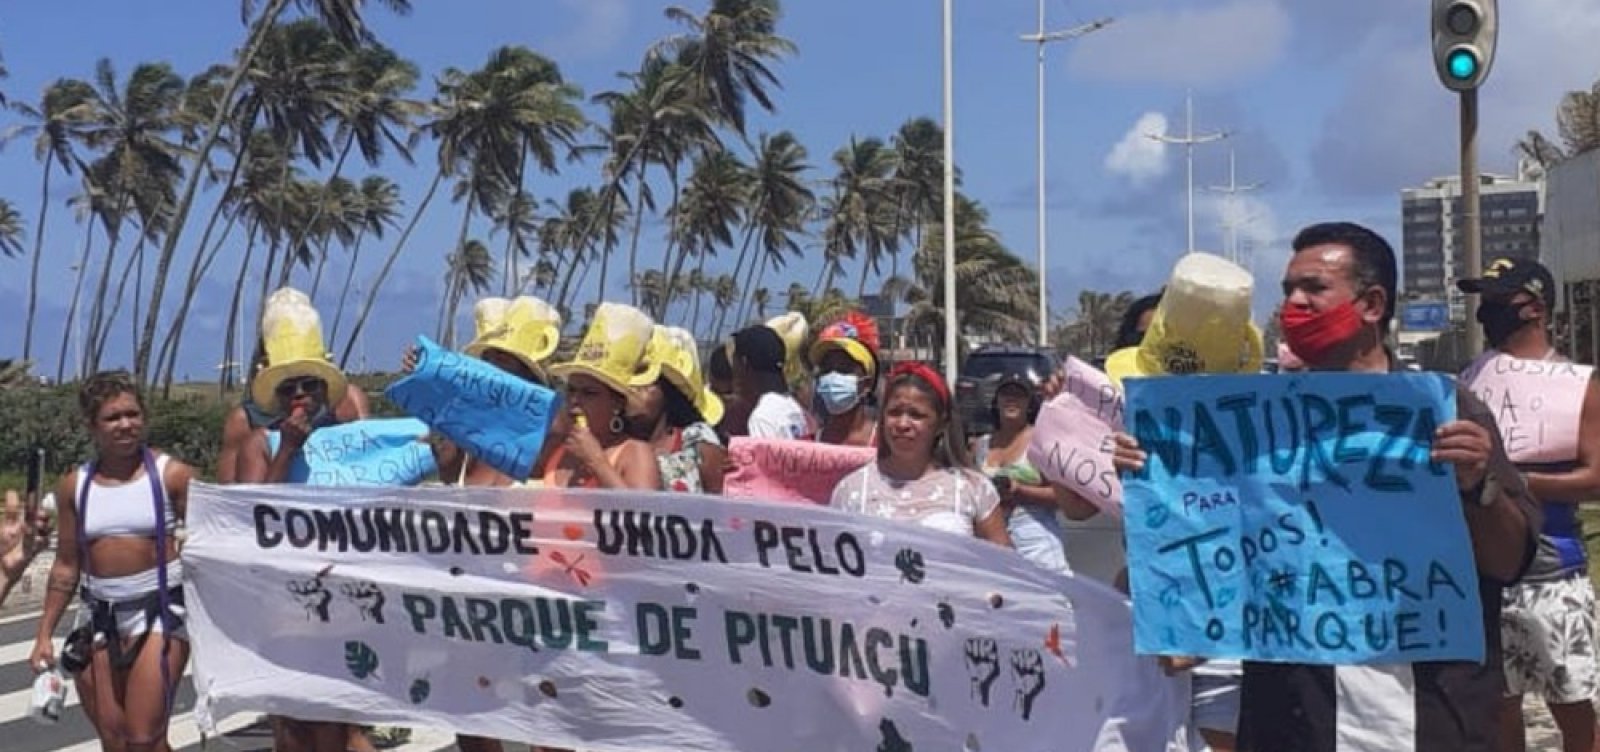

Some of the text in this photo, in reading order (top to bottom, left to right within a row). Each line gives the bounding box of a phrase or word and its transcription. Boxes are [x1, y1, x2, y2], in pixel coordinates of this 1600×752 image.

[436, 351, 546, 417] PARQUE
[306, 428, 382, 464] ABRA
[1048, 441, 1113, 498] NOS
[1183, 491, 1237, 516] PARA
[253, 503, 865, 577] COMUNIDADE UNIDA PELO
[402, 593, 931, 697] PARQUE DE PITUAÇÚ
[1242, 602, 1448, 652] PARQUE!
